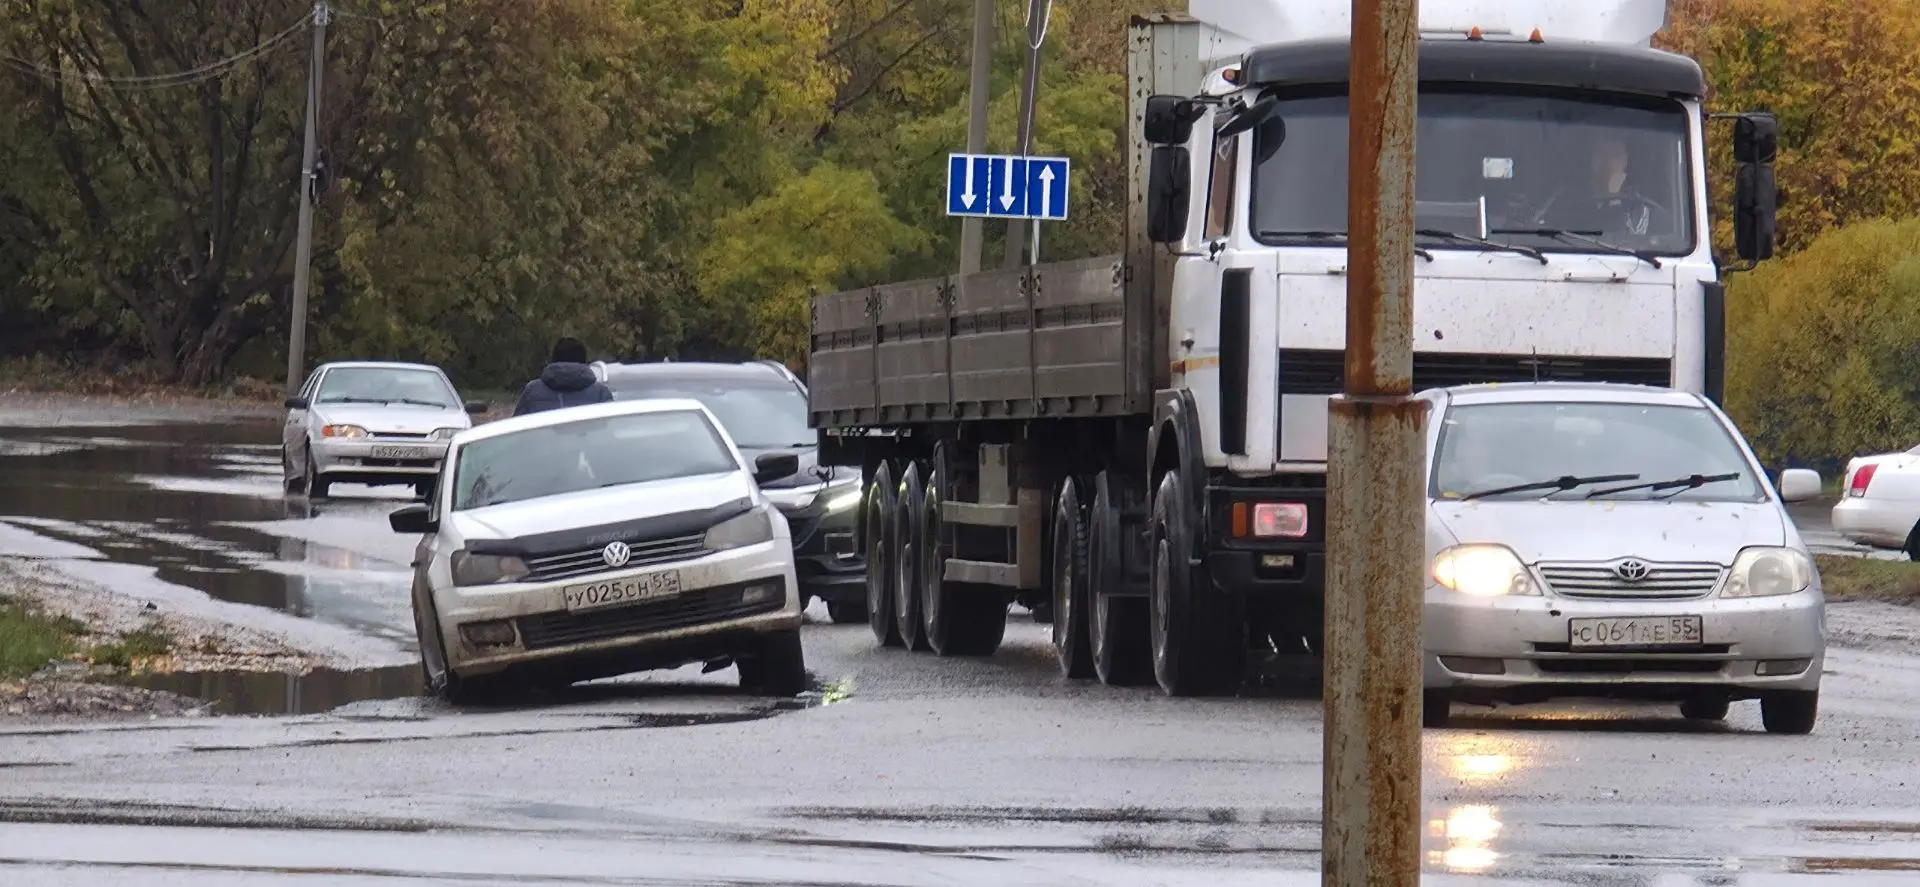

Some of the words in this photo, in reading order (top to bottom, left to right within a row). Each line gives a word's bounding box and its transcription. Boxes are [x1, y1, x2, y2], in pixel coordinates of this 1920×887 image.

[574, 580, 649, 606] У025СН
[1580, 621, 1665, 643] С061АЕ
[1671, 619, 1694, 635] 55
